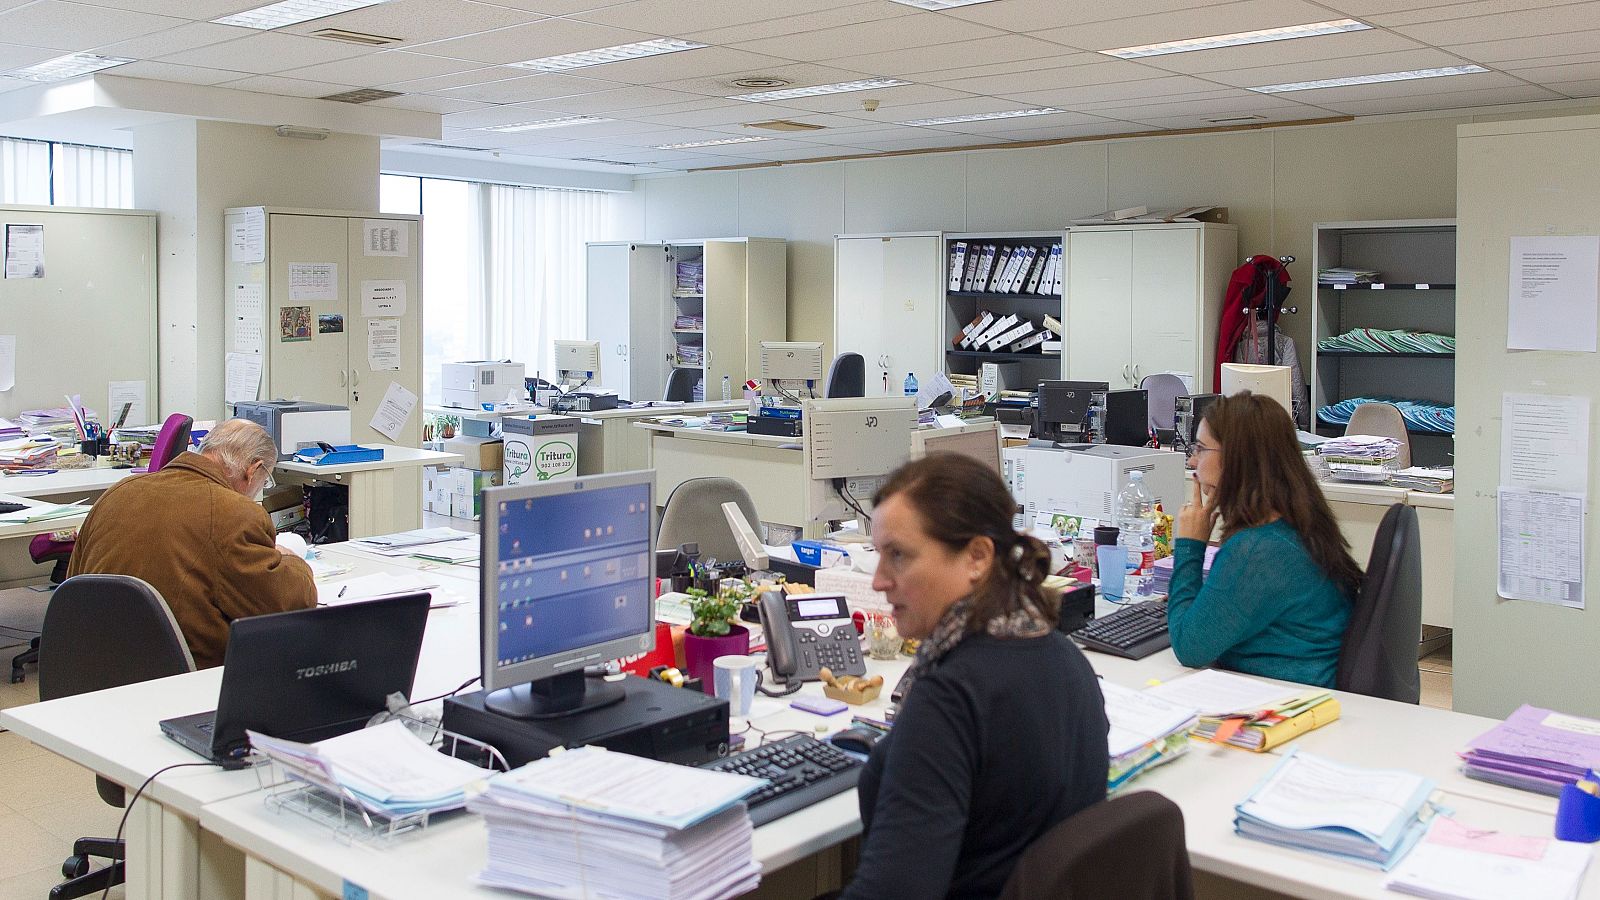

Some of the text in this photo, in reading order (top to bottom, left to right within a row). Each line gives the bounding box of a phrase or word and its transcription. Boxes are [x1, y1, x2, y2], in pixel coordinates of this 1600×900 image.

[506, 448, 528, 460] Tritura
[540, 451, 572, 461] Tritura
[296, 660, 358, 679] TOSHIBA
